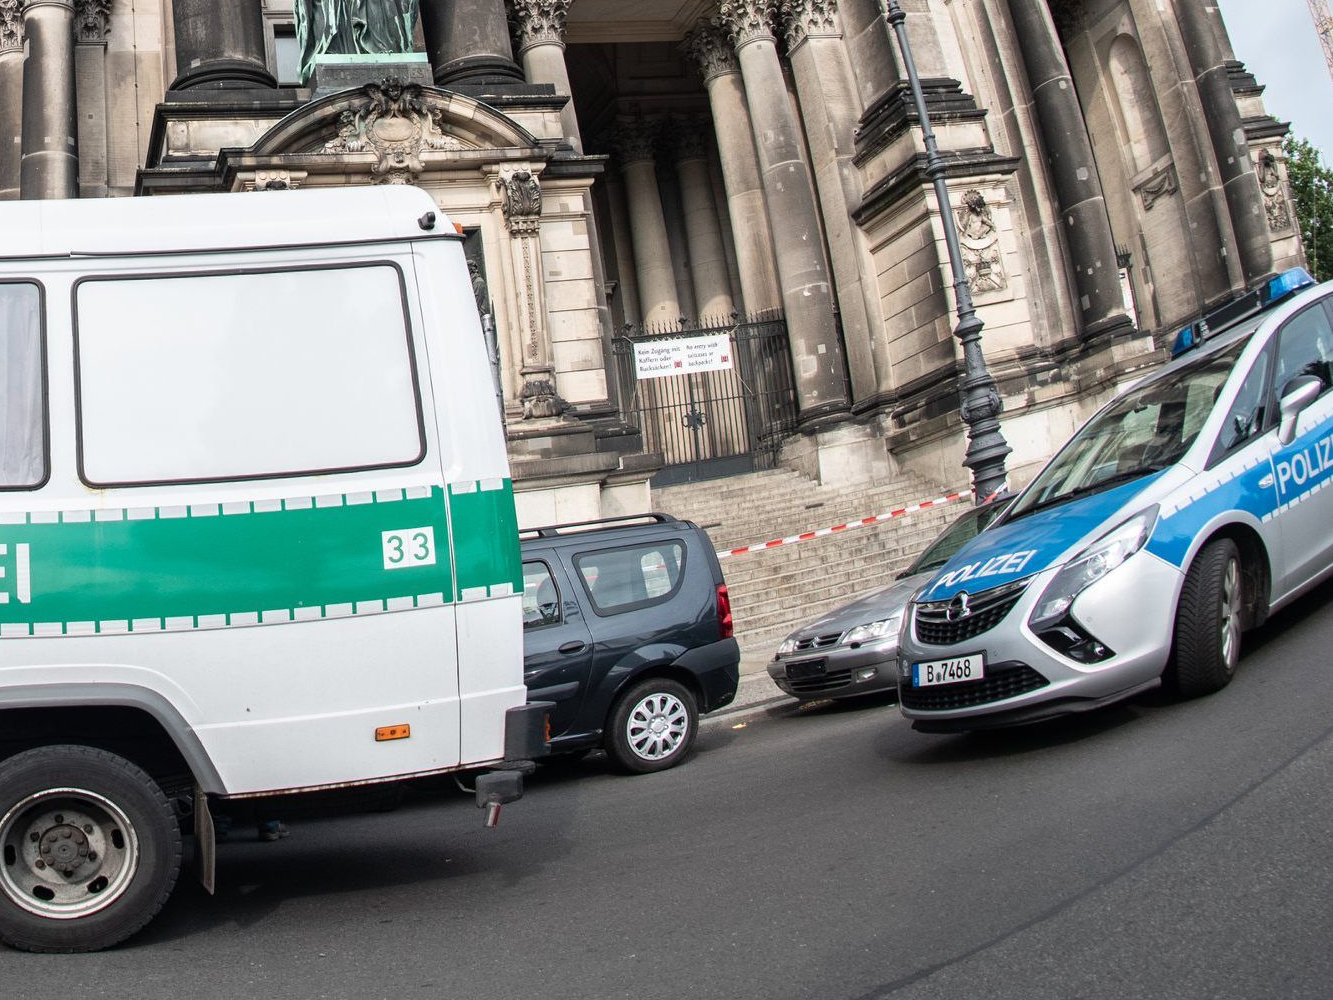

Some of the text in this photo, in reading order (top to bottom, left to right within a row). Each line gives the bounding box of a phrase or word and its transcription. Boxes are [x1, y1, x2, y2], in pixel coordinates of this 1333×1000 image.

[1276, 433, 1333, 494] POLIZ
[386, 532, 429, 563] 33
[928, 550, 1037, 595] POLIZEI
[927, 658, 971, 683] B 7468
